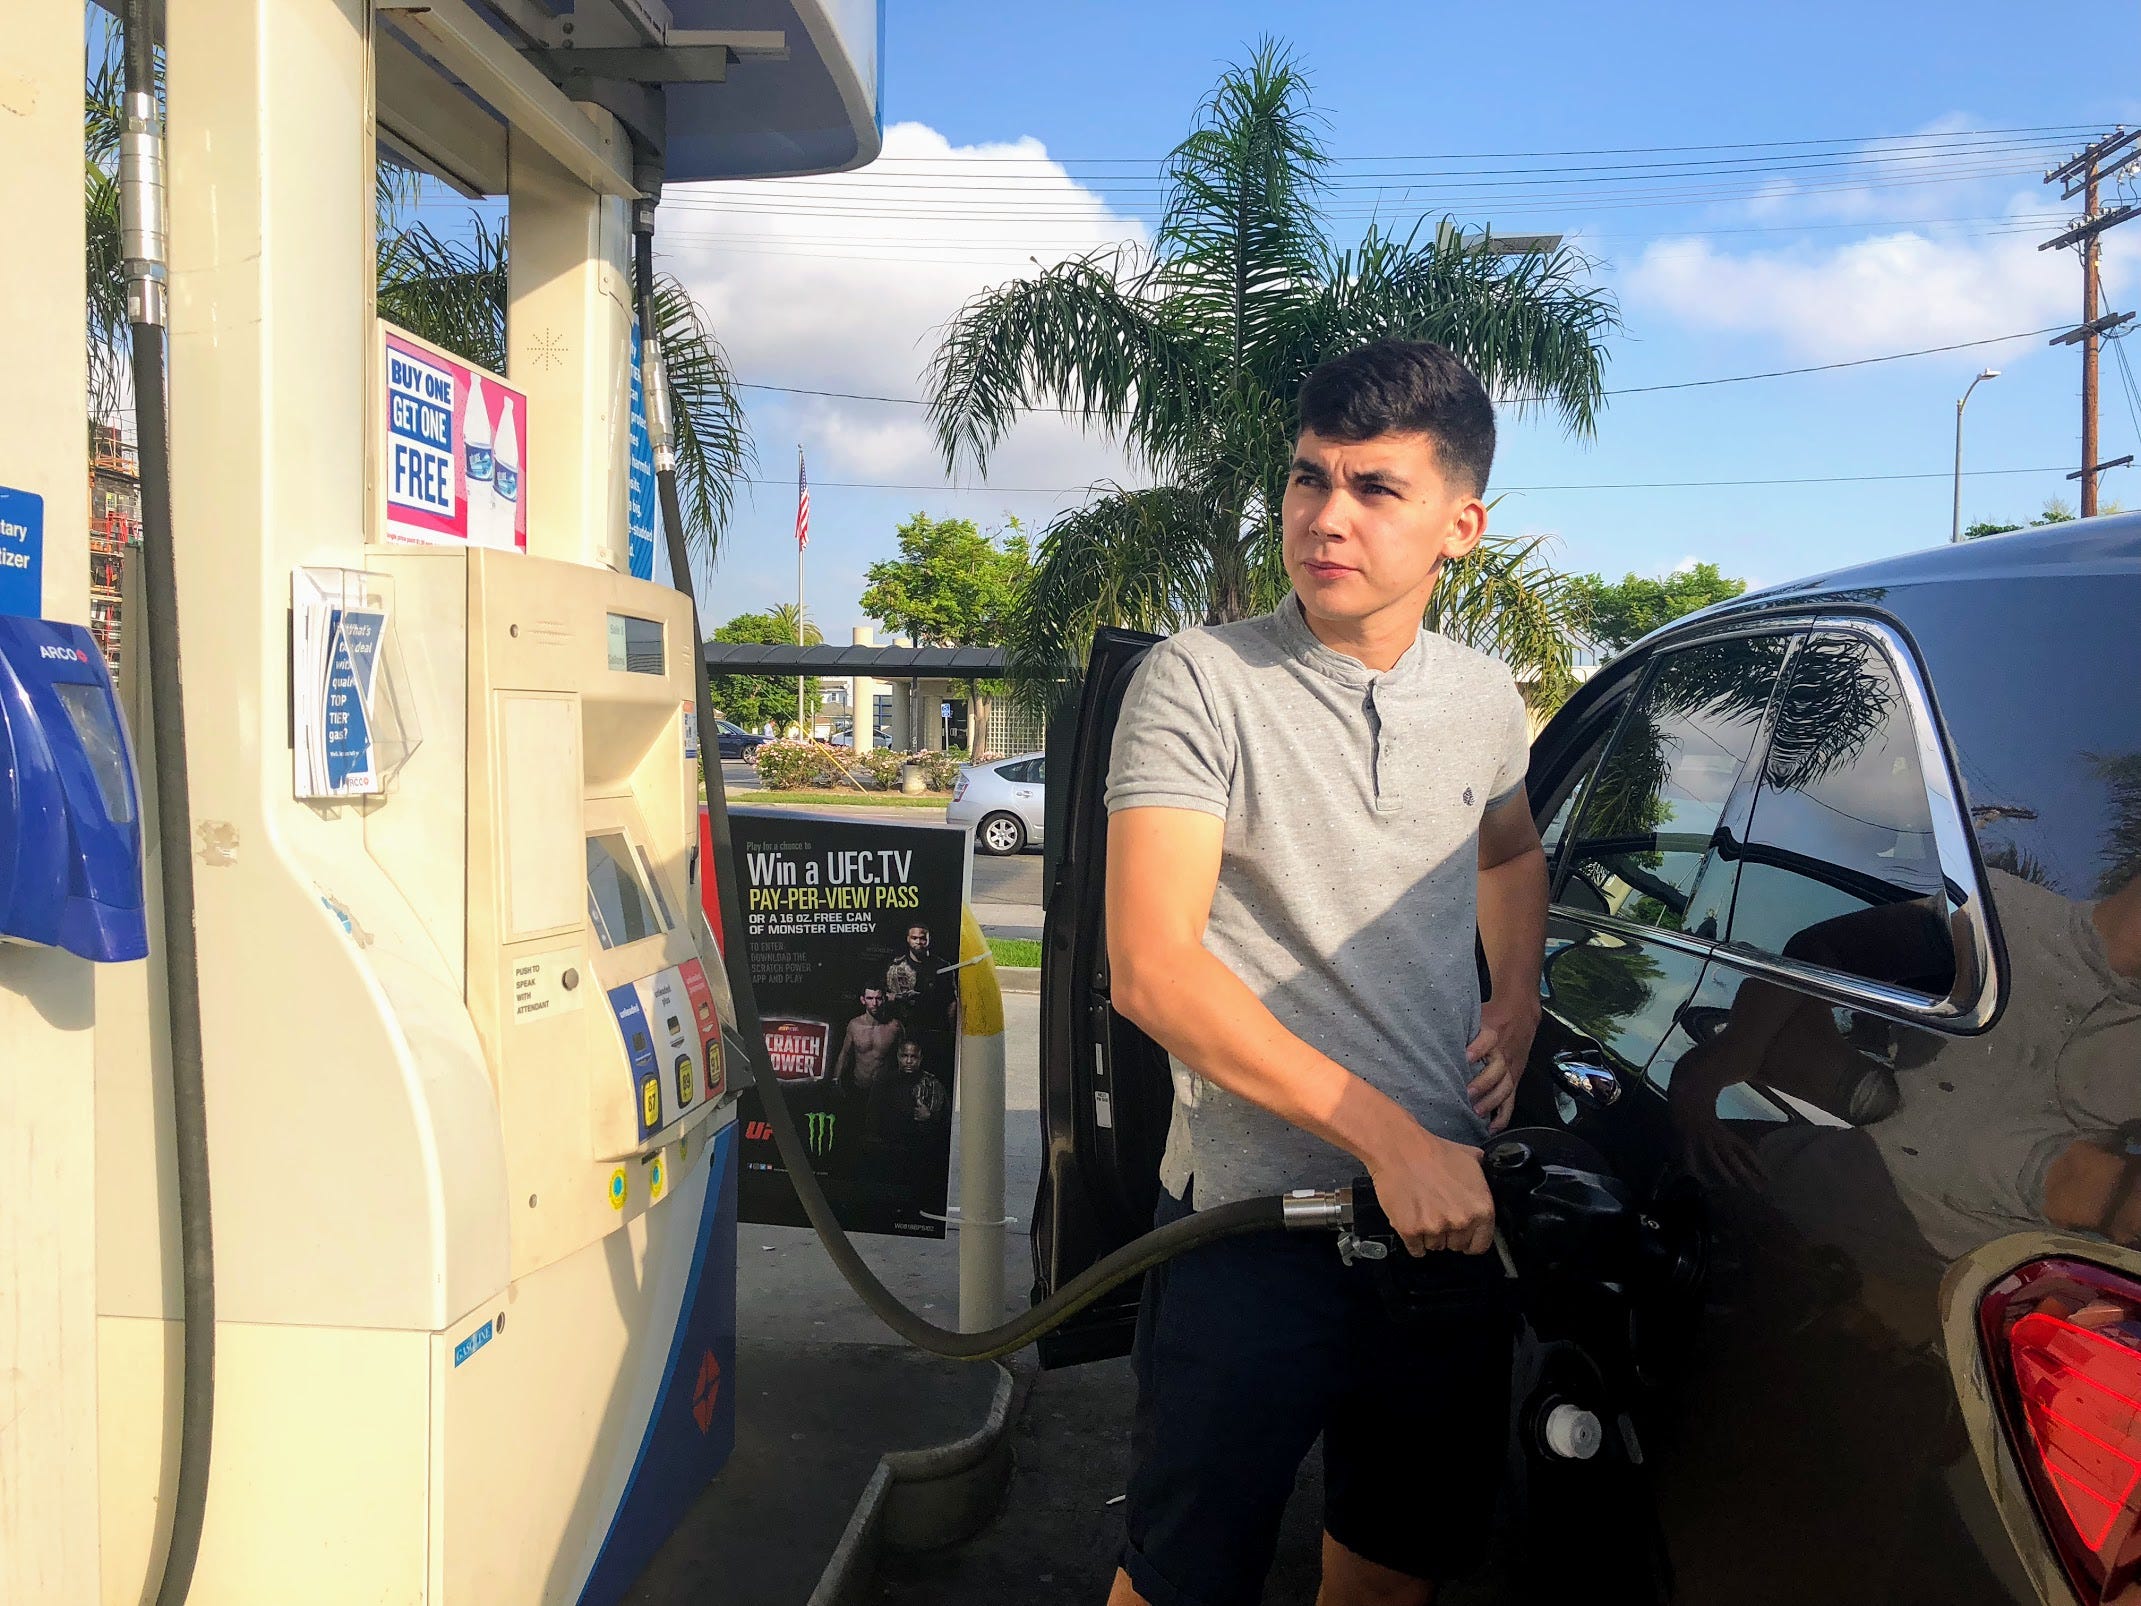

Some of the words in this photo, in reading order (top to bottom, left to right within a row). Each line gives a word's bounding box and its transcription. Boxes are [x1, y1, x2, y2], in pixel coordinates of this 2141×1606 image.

[391, 358, 422, 393] BUY
[425, 374, 451, 405] ONE
[393, 395, 418, 433] GET
[421, 408, 447, 444] ONE
[631, 453, 651, 476] harmful
[395, 443, 449, 508] FREE
[633, 499, 642, 518] big,
[40, 645, 77, 661] ARCO
[354, 641, 372, 654] deal
[331, 694, 347, 707] TOP
[329, 729, 348, 744] gas?
[746, 841, 762, 852] Play
[763, 841, 772, 851] for
[779, 841, 803, 851] chance
[804, 841, 812, 850] to
[746, 852, 796, 886] Win
[805, 861, 819, 885] a
[827, 850, 912, 884] UFC.TV
[750, 887, 870, 911] PAY-PER-VIEW
[875, 885, 919, 909] PASS
[749, 914, 765, 923] OR
[769, 914, 780, 923] A
[781, 913, 793, 923] 16
[814, 912, 843, 922] FREE
[846, 912, 872, 922] CAN
[749, 925, 764, 934] OF
[768, 924, 827, 934] MONSTER
[830, 923, 877, 934] ENERGY
[750, 942, 759, 951] TO
[761, 942, 784, 951] ENTER
[751, 952, 791, 962] DOWNLOAD
[793, 951, 808, 962] THE
[516, 967, 531, 976] PUSH
[532, 965, 540, 973] TO
[751, 963, 784, 973] SCRATCH
[785, 963, 812, 972] POWER
[516, 978, 536, 989] SPEAK
[752, 974, 767, 983] APP
[768, 974, 783, 983] AND
[785, 974, 803, 983] PLAY
[516, 992, 531, 1001] WITH
[517, 1000, 549, 1014] ATTENDANT
[764, 1033, 820, 1056] CRATCH
[711, 1053, 719, 1073] 91
[770, 1053, 816, 1079] OWER
[648, 1094, 655, 1112] 87
